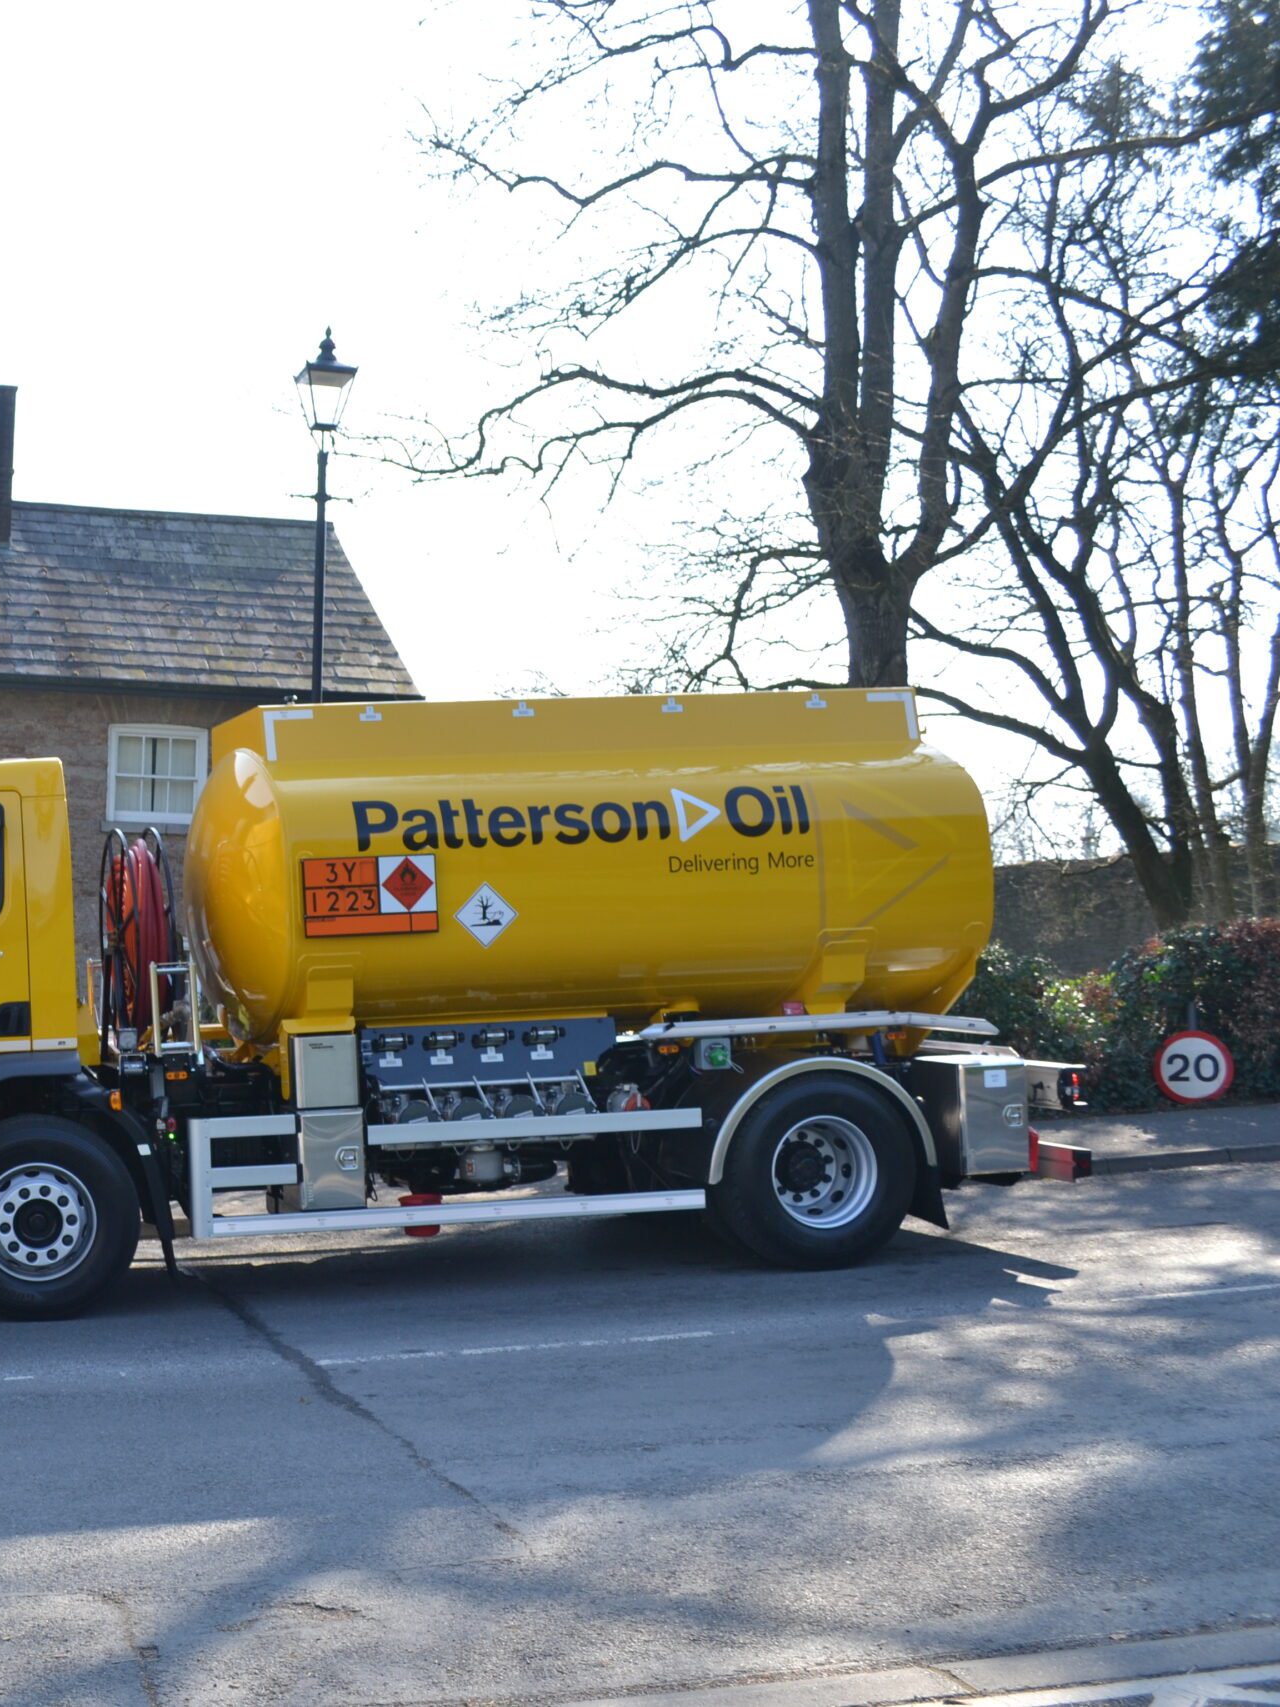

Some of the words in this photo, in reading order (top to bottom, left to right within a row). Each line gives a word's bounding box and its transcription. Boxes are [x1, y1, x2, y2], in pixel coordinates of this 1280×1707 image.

[352, 798, 671, 852] Patterson
[724, 784, 810, 837] Oil
[325, 861, 357, 883] 3Y
[668, 853, 760, 875] Delivering
[767, 851, 815, 869] More
[311, 890, 376, 913] 1223
[1166, 1052, 1220, 1083] 20
